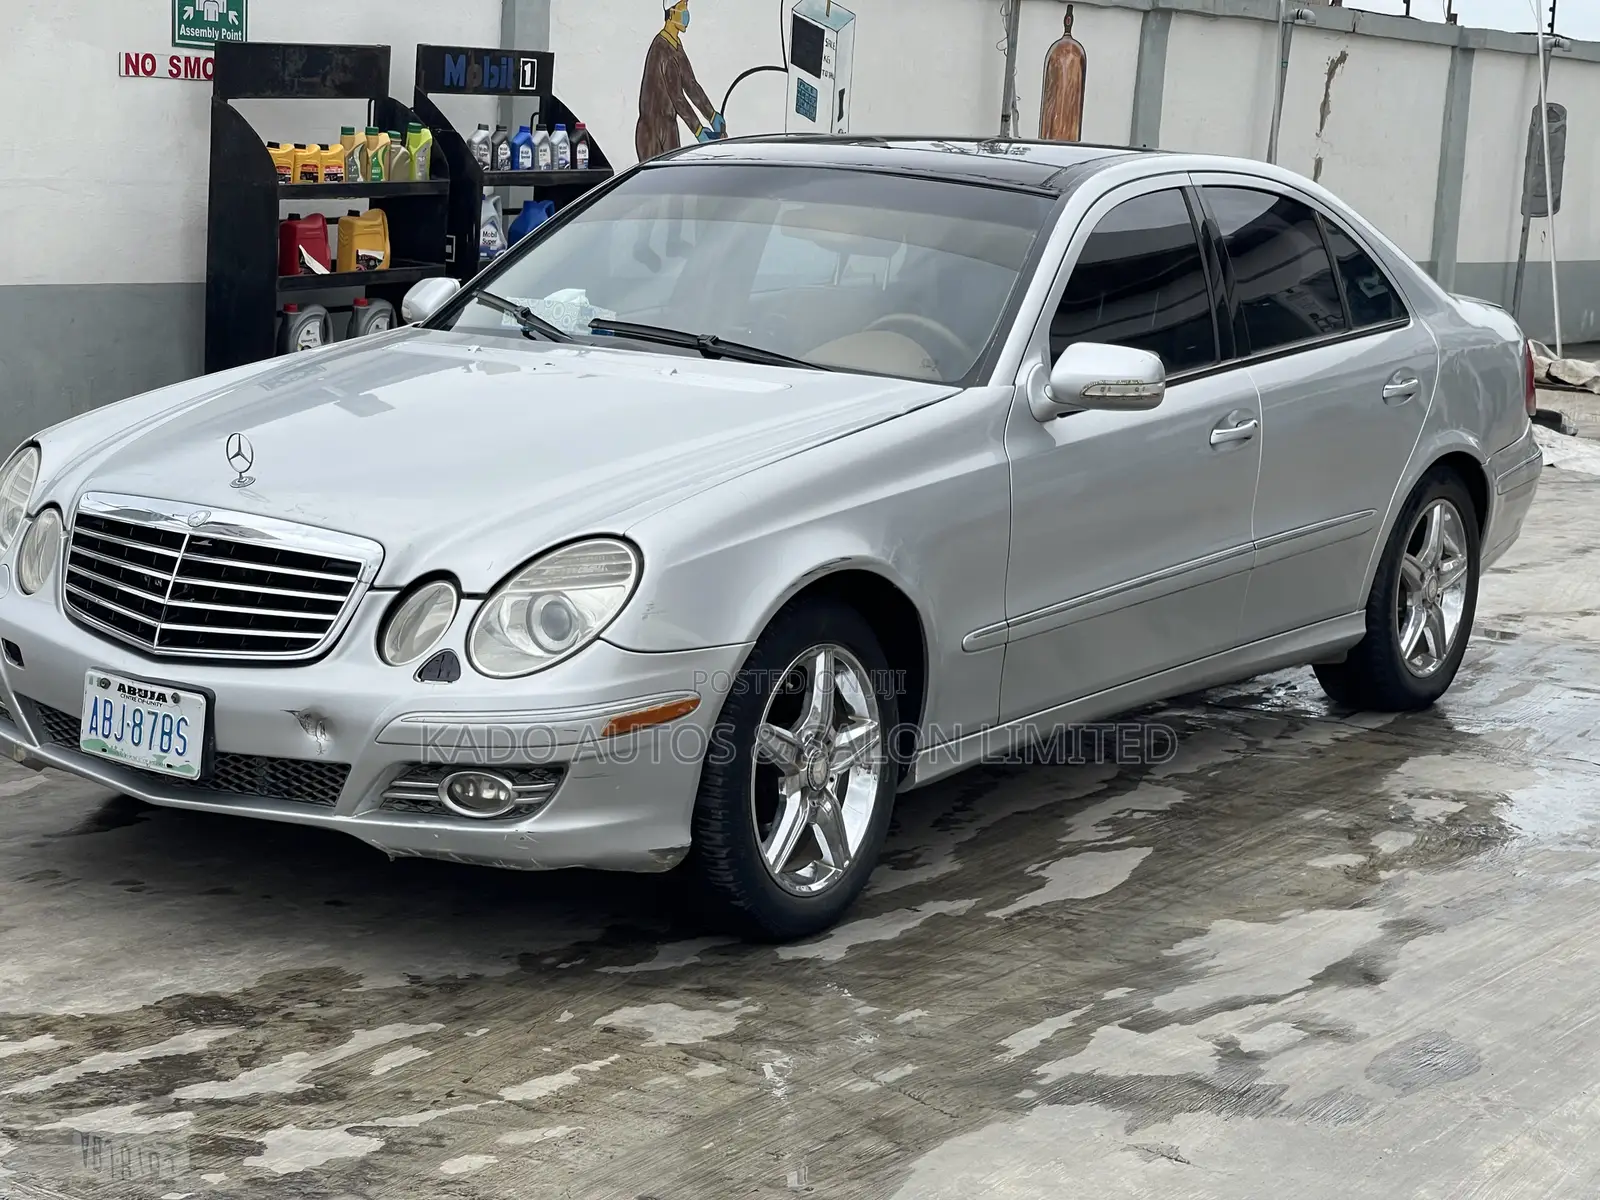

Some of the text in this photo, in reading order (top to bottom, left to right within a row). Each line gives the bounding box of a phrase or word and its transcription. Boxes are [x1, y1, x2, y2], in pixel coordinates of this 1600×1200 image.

[180, 23, 242, 41] Assembly Point
[124, 52, 157, 77] NO
[444, 54, 513, 89] Mobil
[482, 230, 498, 238] Mobil
[117, 683, 167, 703] ABUJA
